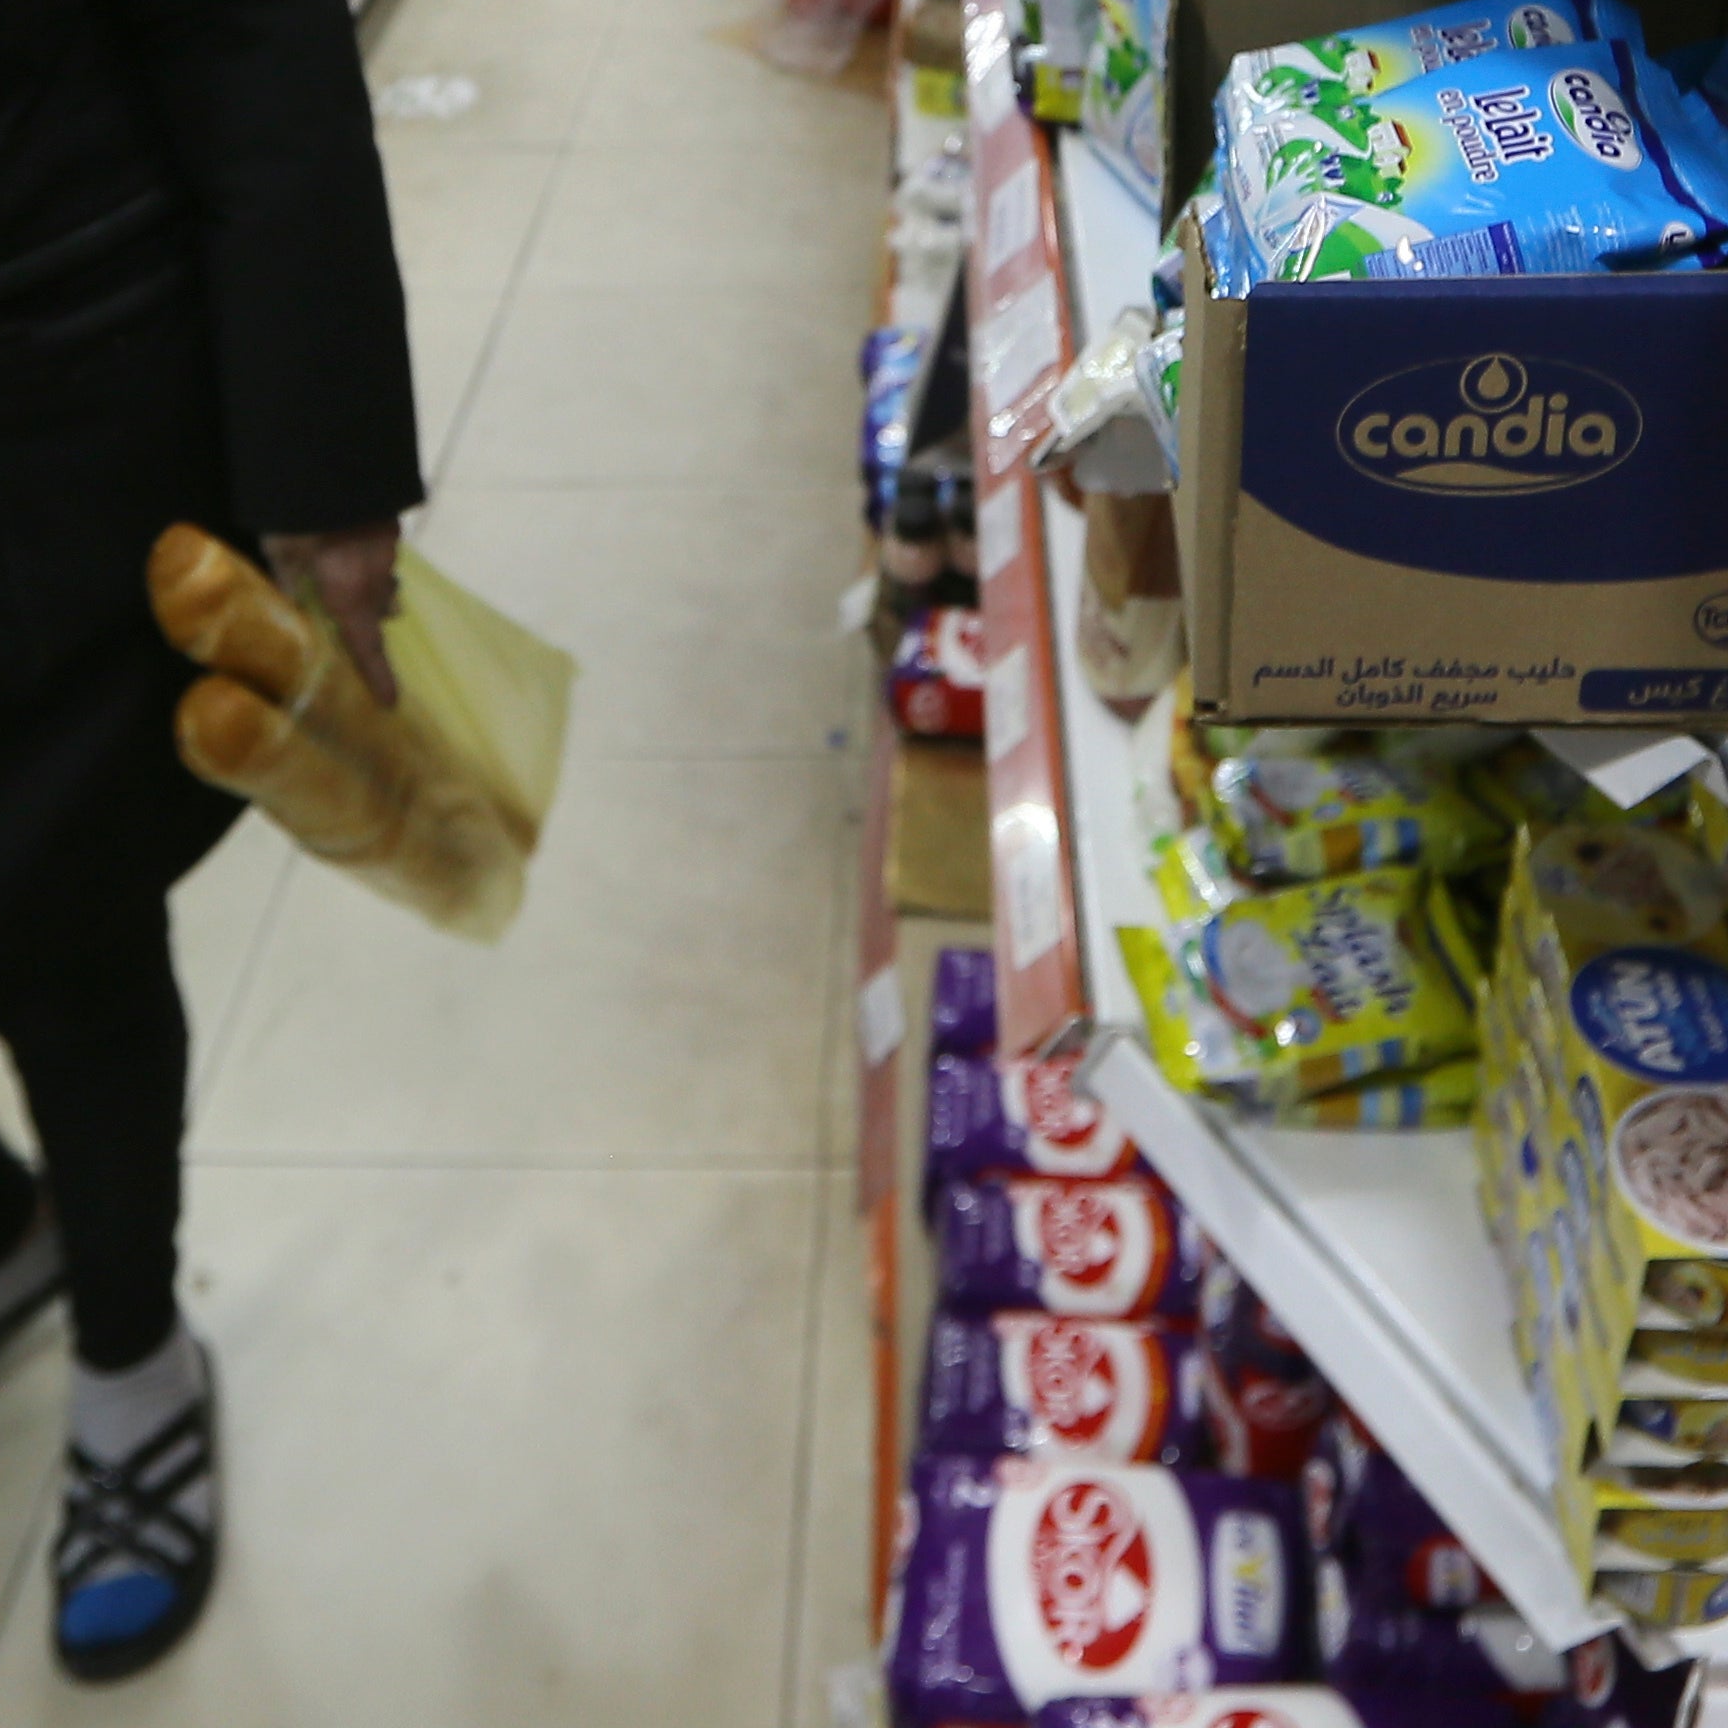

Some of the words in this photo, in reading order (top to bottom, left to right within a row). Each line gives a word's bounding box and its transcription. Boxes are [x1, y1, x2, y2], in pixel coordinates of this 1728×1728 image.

[1438, 89, 1466, 114] en
[1564, 72, 1633, 159] candia
[1440, 114, 1499, 184] poudre
[1353, 393, 1617, 459] candia
[1252, 658, 1336, 684] الدسم
[1342, 657, 1406, 684] كامل
[1412, 657, 1502, 682] مجفف
[1507, 657, 1577, 684] حليب
[1336, 684, 1424, 711] الذوبان
[1430, 686, 1499, 711] سريع
